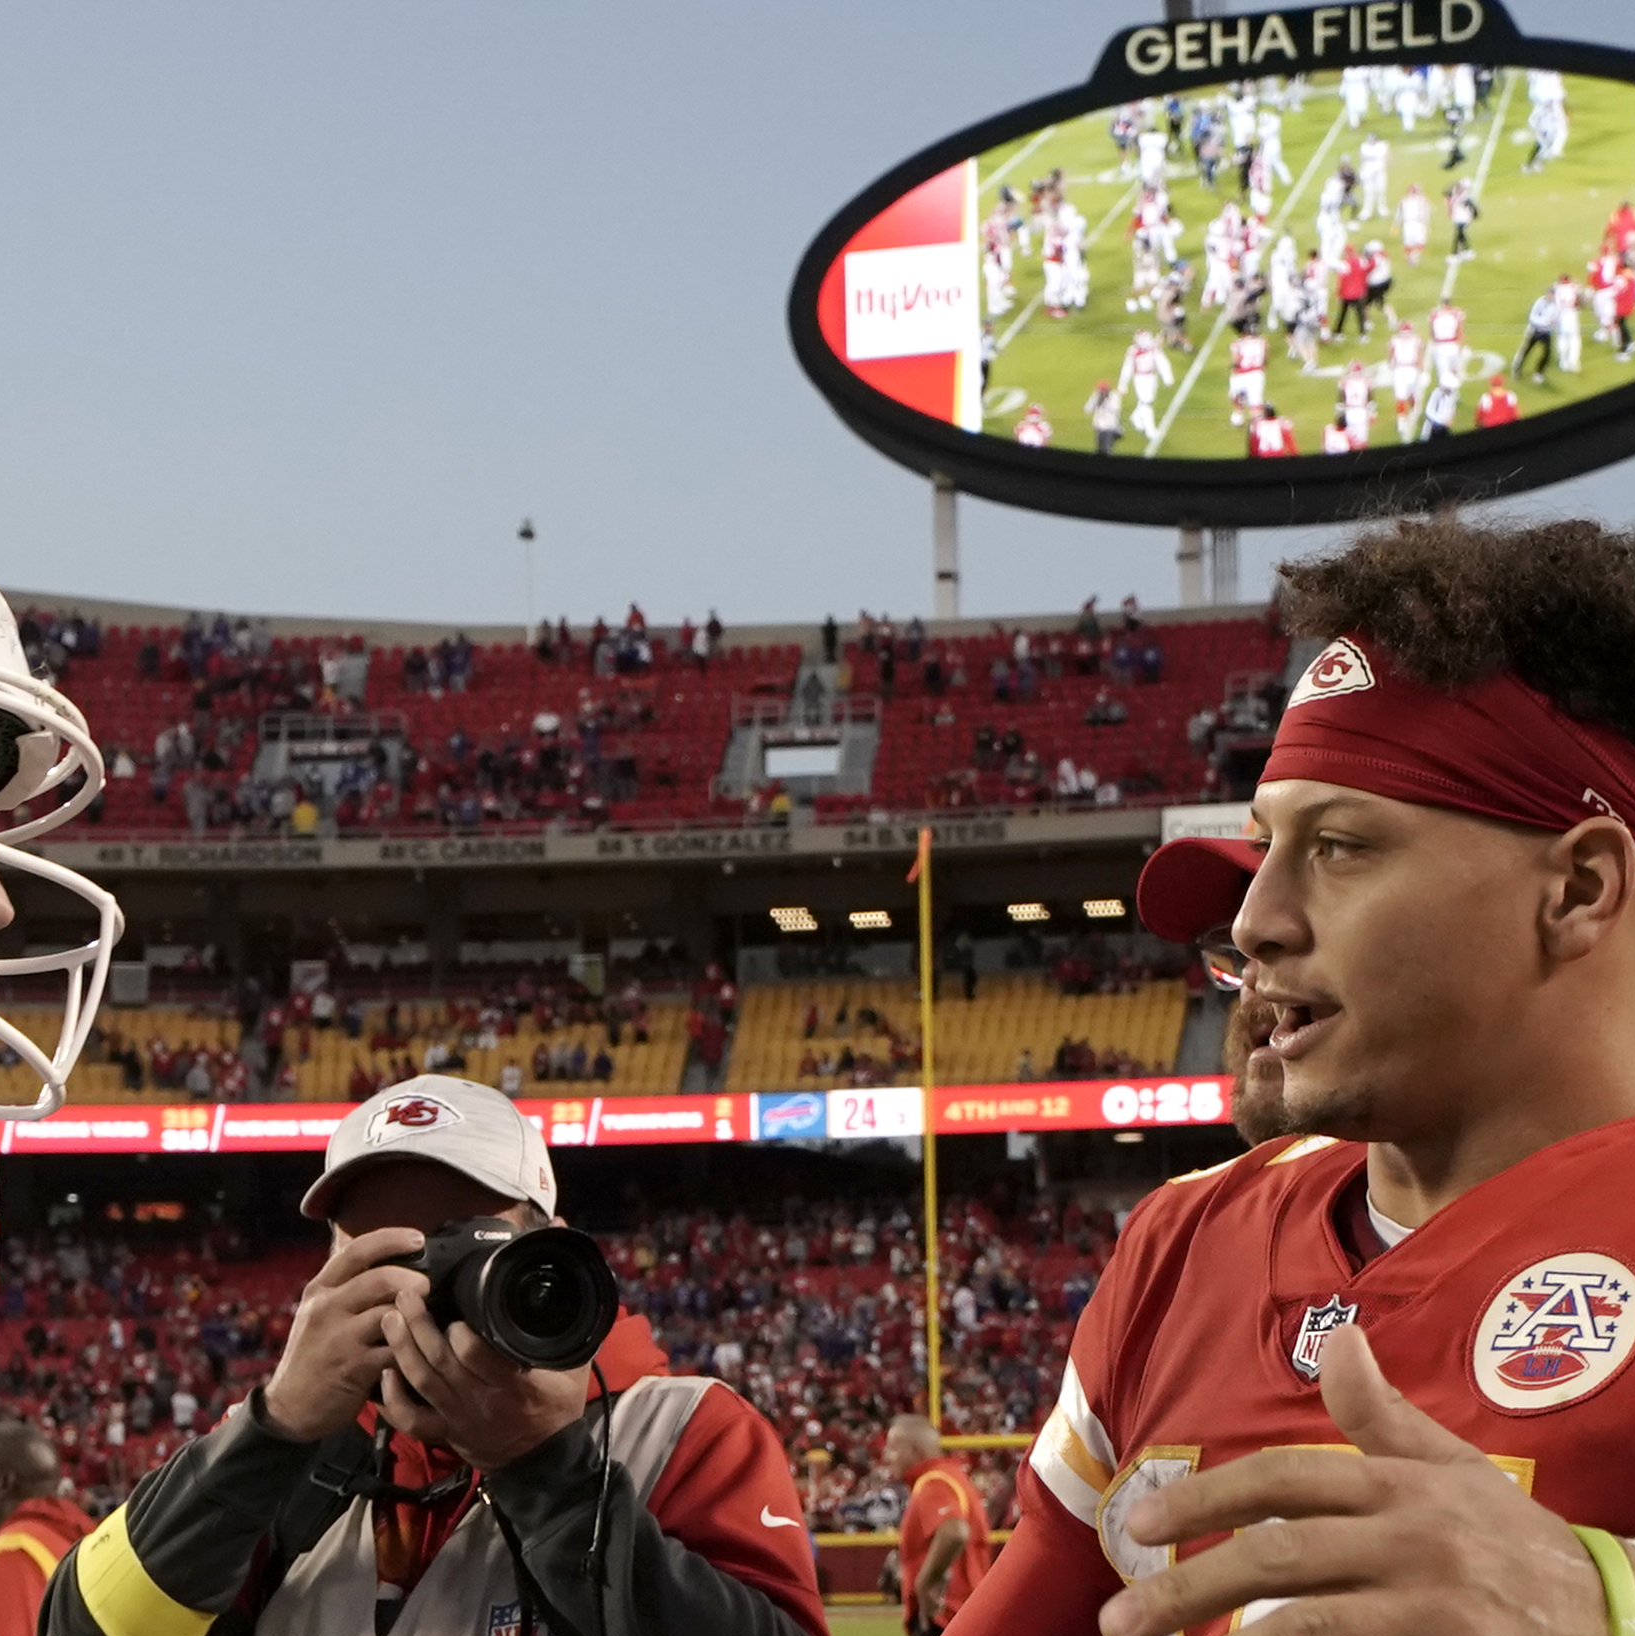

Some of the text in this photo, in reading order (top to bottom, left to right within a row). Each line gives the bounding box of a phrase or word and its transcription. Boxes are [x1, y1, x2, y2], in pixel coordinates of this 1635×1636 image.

[1124, 0, 1484, 76] GEHA FIELD
[439, 841, 546, 861] CARSON
[652, 832, 792, 857] GONZALEZ
[844, 1097, 877, 1131] 24
[944, 1101, 998, 1121] 4TH
[1039, 1096, 1071, 1118] 12
[1101, 1082, 1224, 1124] 0:25
[474, 1229, 513, 1241] Canon
[1521, 1356, 1562, 1377] LH
